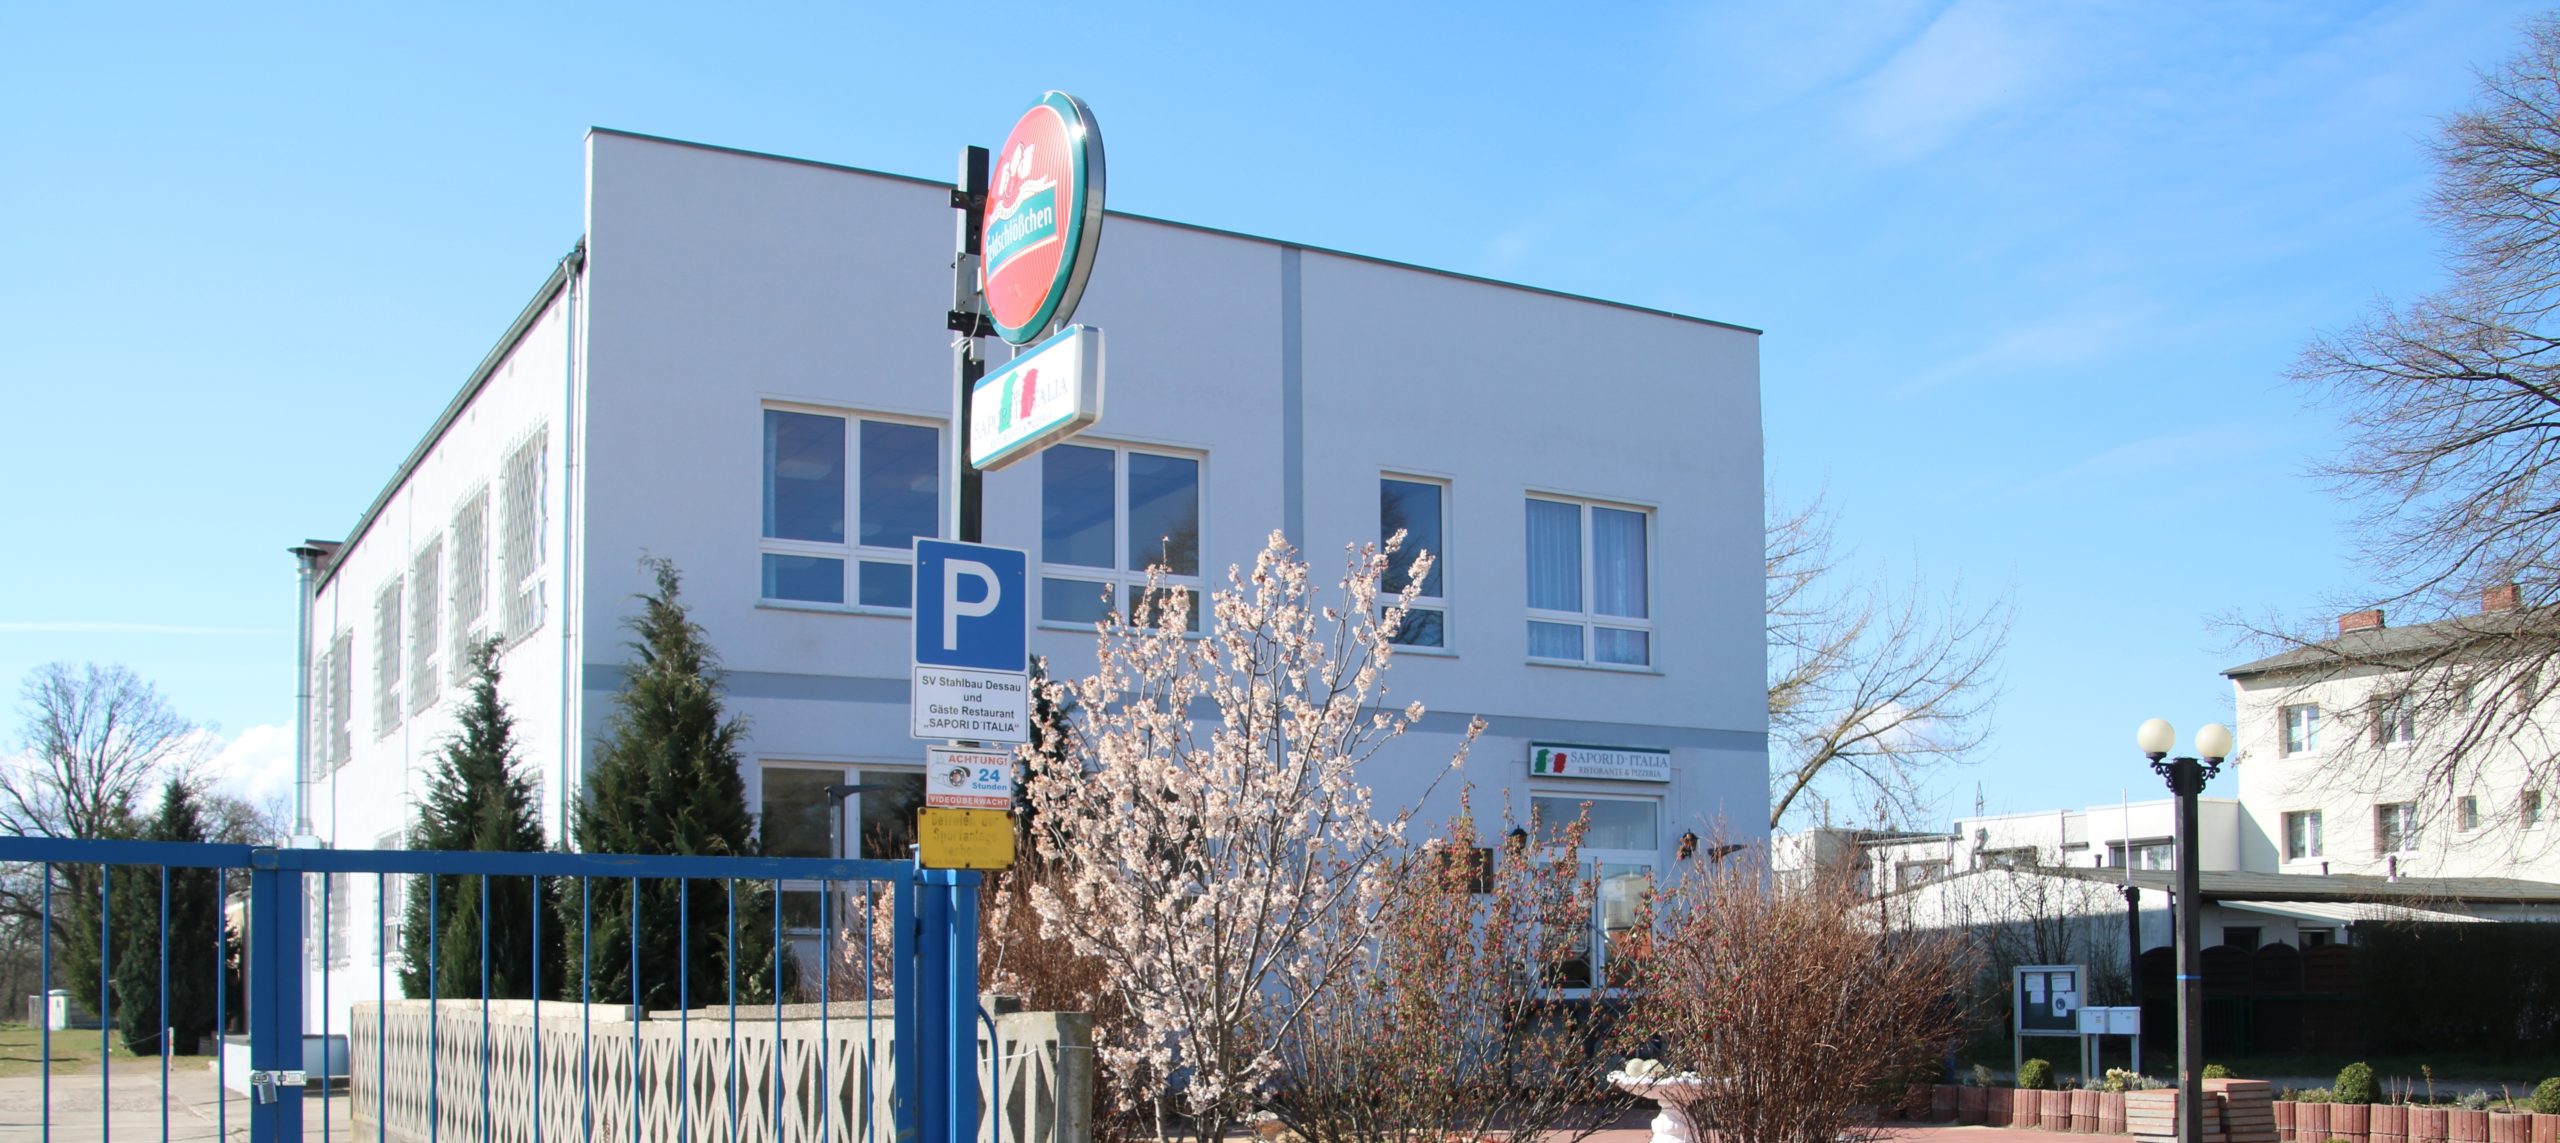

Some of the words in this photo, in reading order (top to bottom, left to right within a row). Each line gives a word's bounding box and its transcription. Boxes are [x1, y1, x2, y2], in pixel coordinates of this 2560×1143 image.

[943, 558, 1001, 651] P
[922, 675, 936, 685] SV
[939, 677, 983, 689] Stahlbau
[986, 680, 1021, 692] Dessau
[963, 693, 982, 702] und
[929, 704, 959, 715] Gäste
[961, 706, 1015, 718] Restaurant
[948, 755, 1008, 765] ACHTUNG!
[1570, 752, 1614, 765] SAPORI
[979, 768, 1000, 782] 24
[1579, 767, 1622, 776] RISTORANTE
[1632, 769, 1661, 777] PIZZERIA
[972, 782, 1007, 791] Stunden
[929, 795, 1008, 806] VIDEOÜBERWACHT
